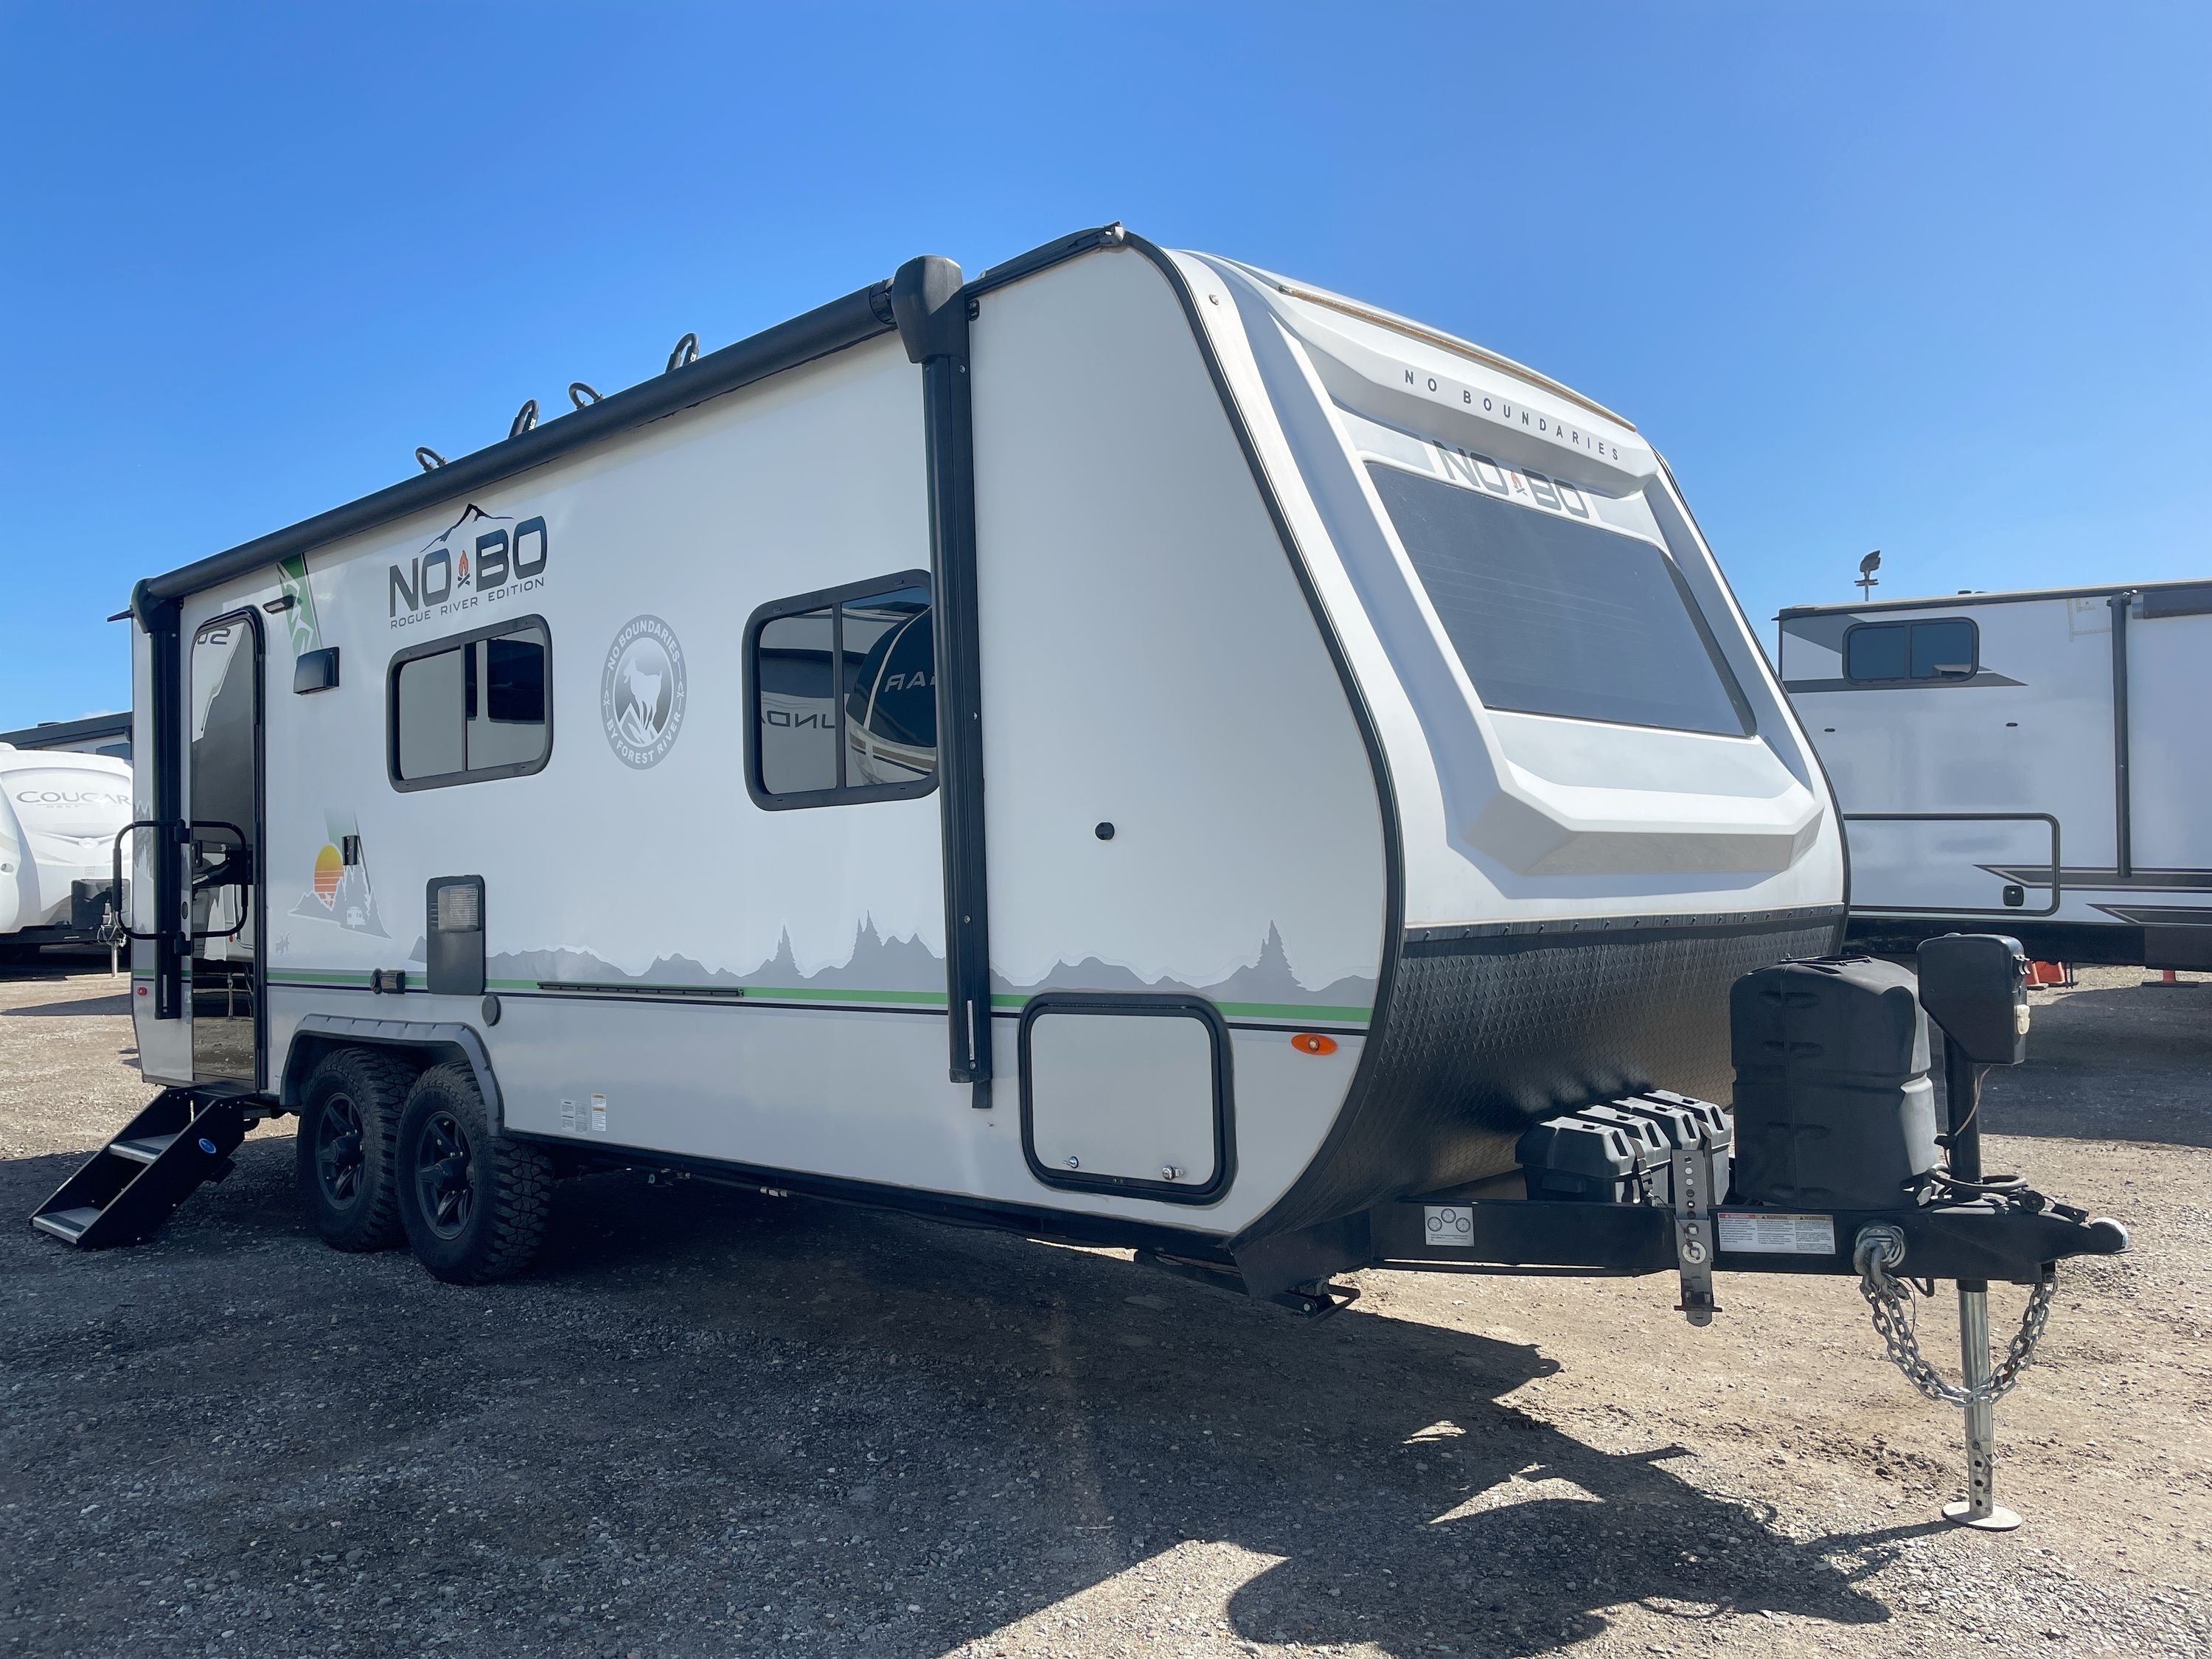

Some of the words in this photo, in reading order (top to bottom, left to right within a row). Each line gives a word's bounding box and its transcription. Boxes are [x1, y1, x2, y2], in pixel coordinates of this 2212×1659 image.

[1405, 369, 1437, 392] NO
[1464, 389, 1618, 461] BOUNDARIES
[1433, 439, 1509, 495] NO
[1521, 467, 1589, 519] BO
[389, 548, 451, 618] NO
[476, 515, 548, 593] BO
[391, 610, 431, 630] ROGUE
[440, 597, 478, 616] RIVER
[488, 577, 544, 602] EDITION
[608, 646, 620, 671] NO
[618, 619, 680, 663] BOUNDARIES
[607, 718, 618, 740] BY
[616, 741, 654, 764] FOREST
[656, 712, 681, 754] RIVER
[16, 791, 131, 805] COUGAR
